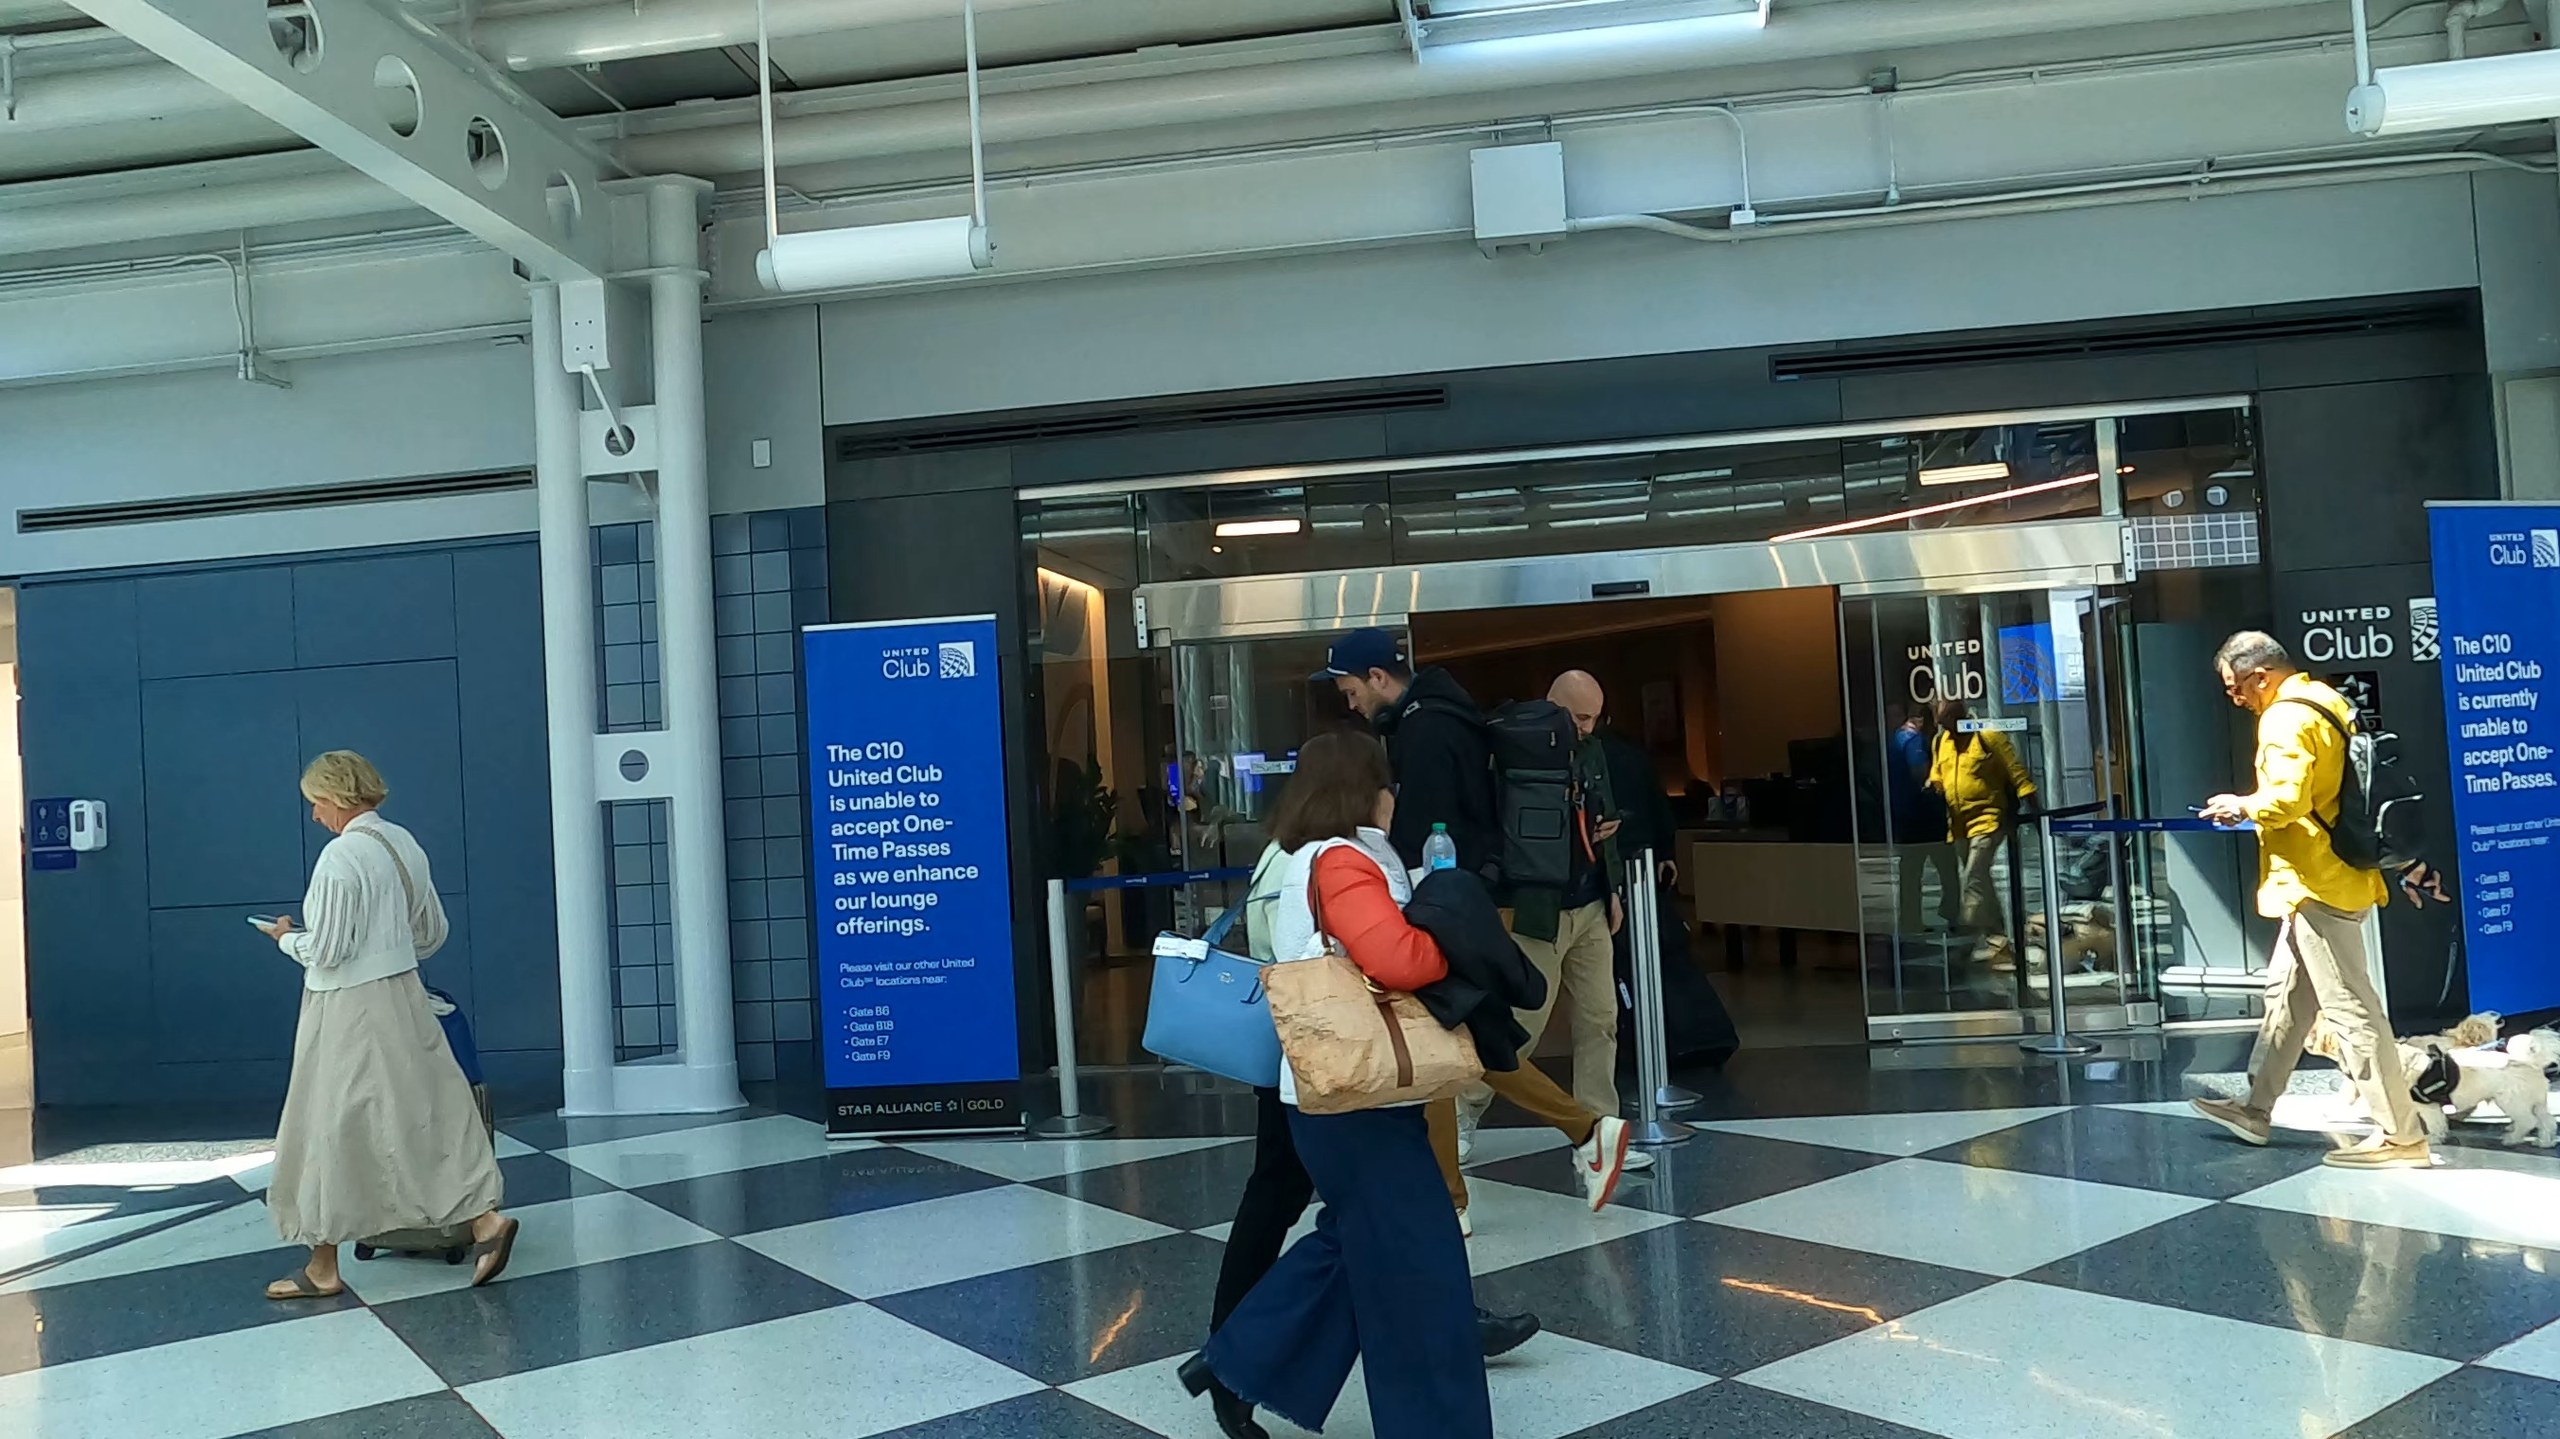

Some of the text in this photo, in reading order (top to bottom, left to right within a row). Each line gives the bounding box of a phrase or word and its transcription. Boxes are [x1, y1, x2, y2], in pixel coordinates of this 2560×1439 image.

[2490, 544, 2527, 565] Club
[2302, 606, 2391, 624] UNITED
[882, 647, 930, 657] UNITED
[1907, 639, 1981, 660] UNITED
[2303, 625, 2394, 662] Club
[2453, 634, 2512, 655] The C10
[882, 658, 931, 679] Club
[2455, 660, 2542, 683] United Club
[1909, 661, 1983, 704] Club
[2457, 688, 2538, 711] is currently
[2460, 716, 2528, 738] unable to
[826, 741, 904, 762] The C10
[2463, 742, 2554, 768] accept One-
[828, 764, 943, 788] United Club
[2464, 771, 2558, 794] Time Passes.
[830, 790, 940, 812] is unable to
[831, 815, 954, 838] accept One-
[832, 841, 951, 861] Time Passes
[834, 864, 979, 886] as we enhance
[835, 891, 938, 911] our lounge
[836, 916, 930, 936] offerings.
[839, 957, 975, 974] Please visit our other United
[875, 975, 921, 986] locations
[922, 975, 948, 985] near:
[849, 1006, 873, 1017] Gate
[850, 1022, 874, 1032] Gate
[851, 1035, 889, 1047] Gate E7
[852, 1050, 890, 1062] Gate F9
[838, 1098, 1004, 1116] STAR ALLIANCE GOLD
